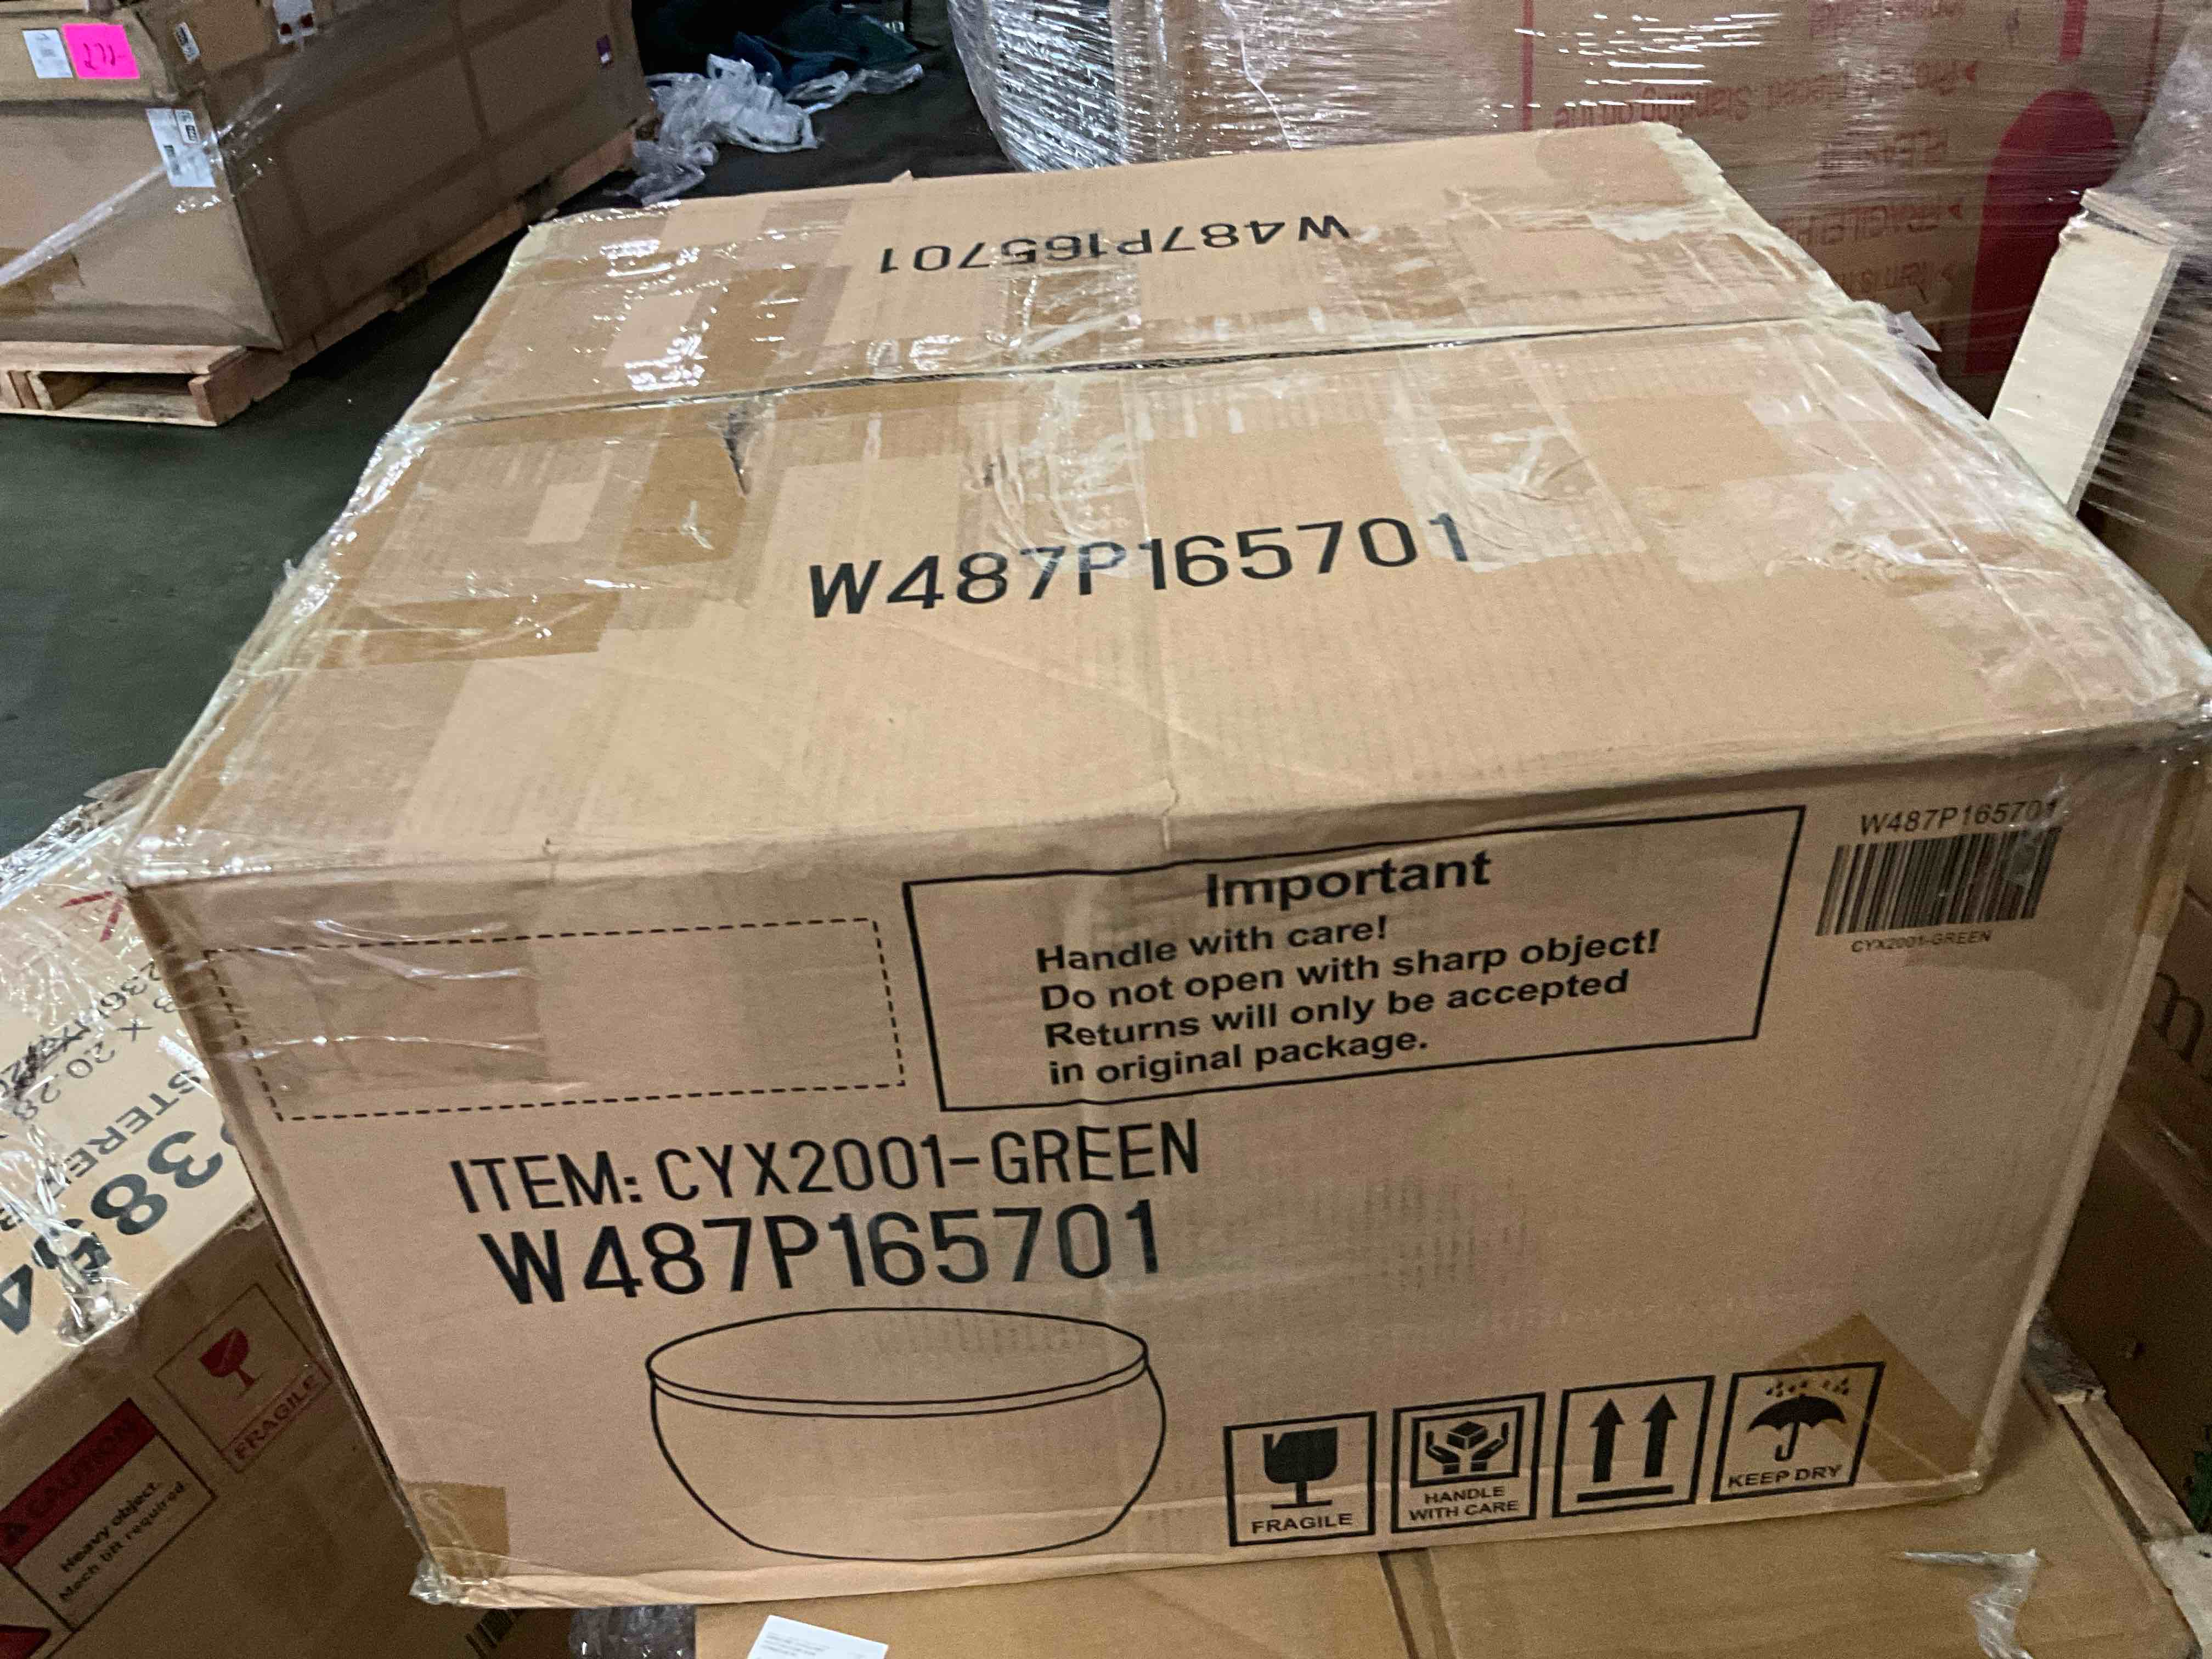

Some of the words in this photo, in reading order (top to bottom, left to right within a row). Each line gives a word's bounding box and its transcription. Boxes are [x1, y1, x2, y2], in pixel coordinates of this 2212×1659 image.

[881, 215, 1351, 273] W487P165701
[809, 513, 1469, 618] W487P165701
[1860, 800, 2058, 836] W487P165701
[1207, 850, 1491, 911] Important
[1036, 939, 1178, 973] Handle
[1189, 926, 1273, 956] with
[1288, 915, 1387, 947] care!
[1042, 984, 1095, 1011] Do
[1110, 975, 1175, 1007] not
[1186, 968, 1284, 1000] open
[1296, 955, 1380, 986] with
[1392, 949, 1507, 974] sharp
[1520, 928, 1660, 967] object!
[1045, 1017, 1200, 1048] Returns
[1212, 1002, 1277, 1031] will
[1290, 994, 1374, 1025] only
[1387, 990, 1434, 1015] be
[1446, 968, 1629, 1006] accepted
[1049, 1060, 1084, 1085] in
[1096, 1043, 1242, 1082] original
[1255, 1031, 1427, 1072] package.
[450, 1150, 642, 1213] ITEM:
[657, 1118, 1200, 1203] CYX2001-GREEN
[478, 1199, 1160, 1305] W487P165701
[1424, 1486, 1505, 1504] HANDLE
[1728, 1469, 1791, 1488] KEEP
[1791, 1464, 1843, 1481] DRY
[1251, 1513, 1353, 1534] FRAGILE
[1408, 1506, 1458, 1521] WITH
[1464, 1499, 1519, 1515] CARE
